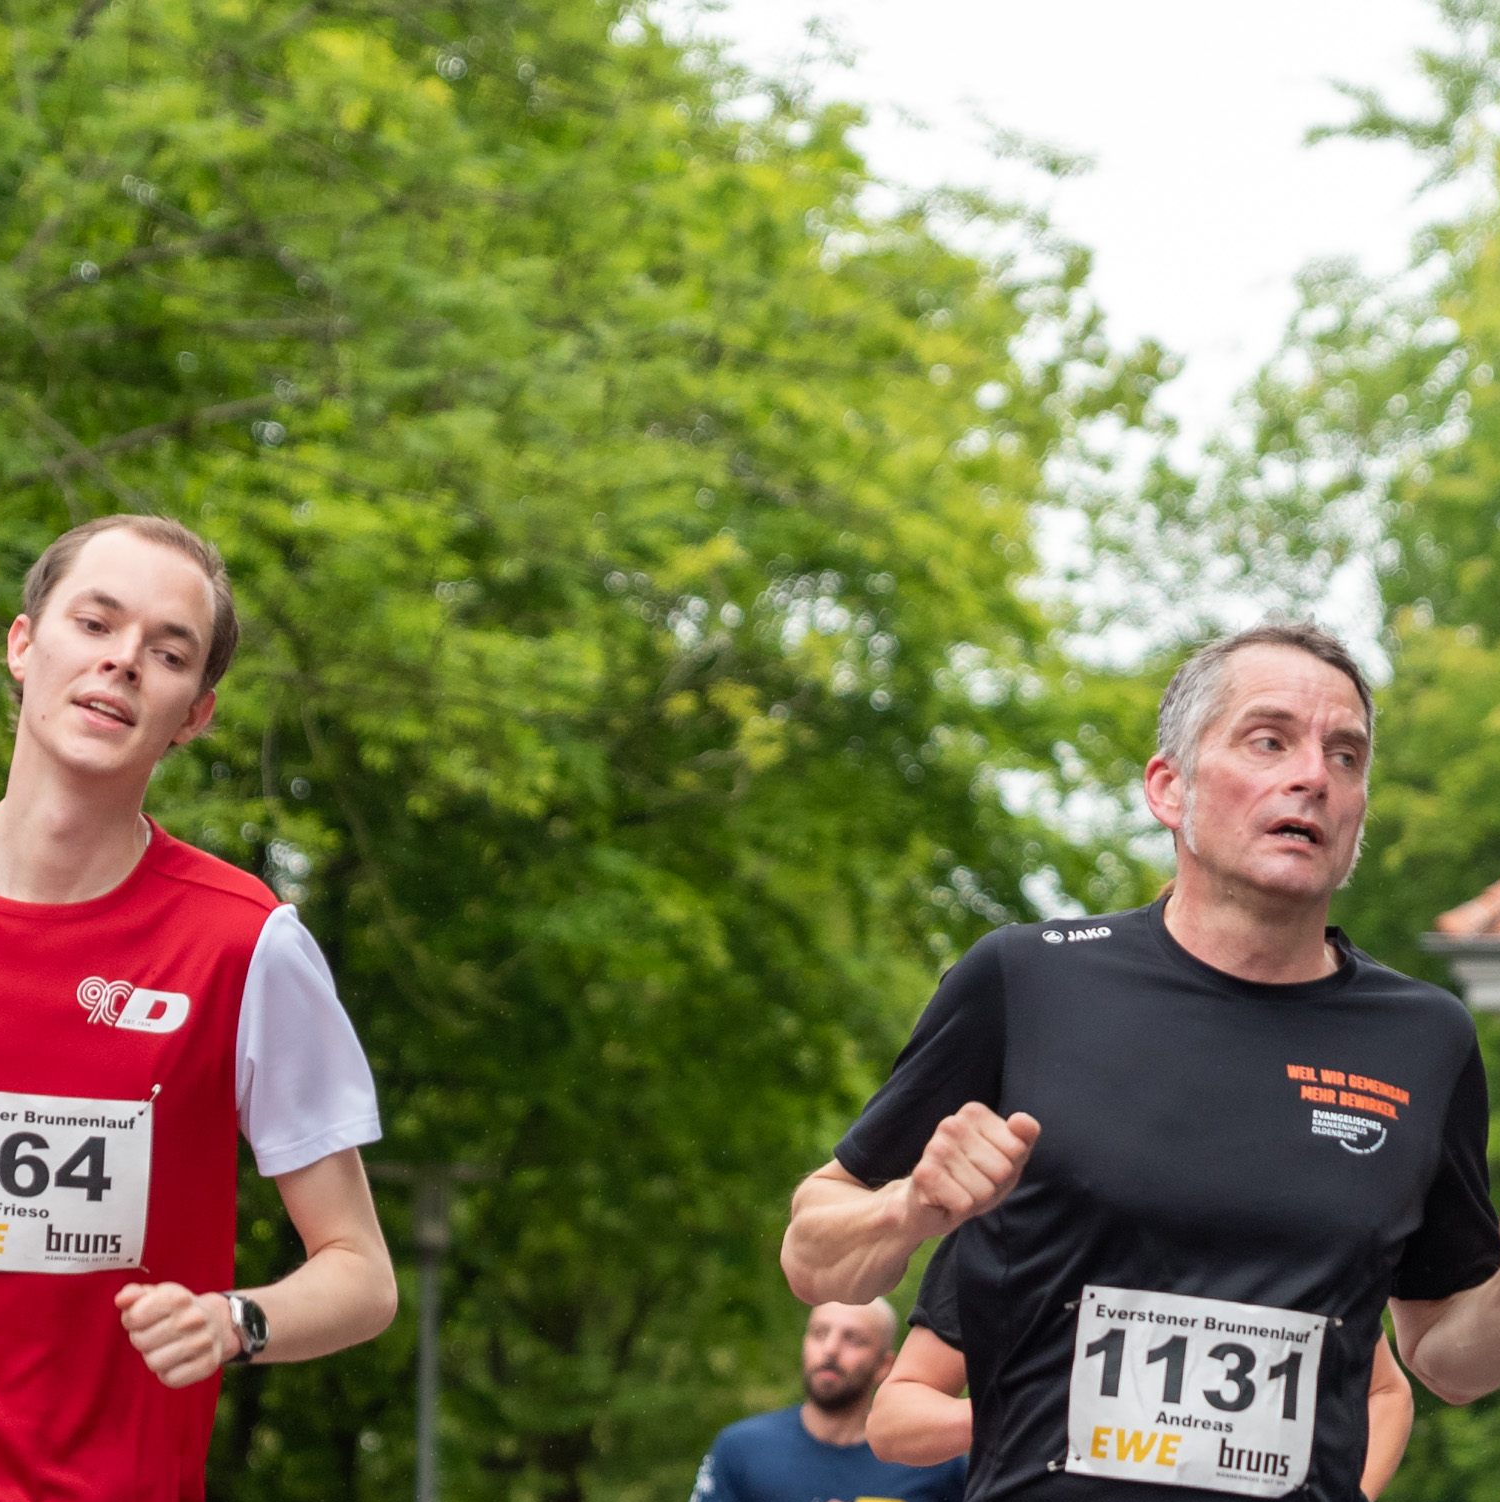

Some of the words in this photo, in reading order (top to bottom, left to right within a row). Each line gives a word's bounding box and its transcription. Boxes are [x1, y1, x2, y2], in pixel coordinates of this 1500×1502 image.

[1067, 926, 1112, 942] JAKO
[1286, 1064, 1318, 1082] WEIL
[1320, 1068, 1346, 1086] WIR
[1348, 1073, 1410, 1106] GEMEINSAM
[1300, 1085, 1337, 1104] MEHR
[23, 1110, 137, 1131] Brunnenlauf
[1311, 1118, 1368, 1136] KRANKENHAUS
[1312, 1109, 1382, 1131] EVANGELISCHES
[1311, 1126, 1359, 1141] OLDENBURG
[45, 1223, 122, 1254] bruns
[1095, 1304, 1199, 1329] Everstener
[1203, 1316, 1312, 1345] Brunnenlauf
[1084, 1327, 1304, 1422] 1131
[1155, 1411, 1235, 1433] Andreas
[1089, 1426, 1183, 1467] EWE
[1218, 1437, 1290, 1477] bruns
